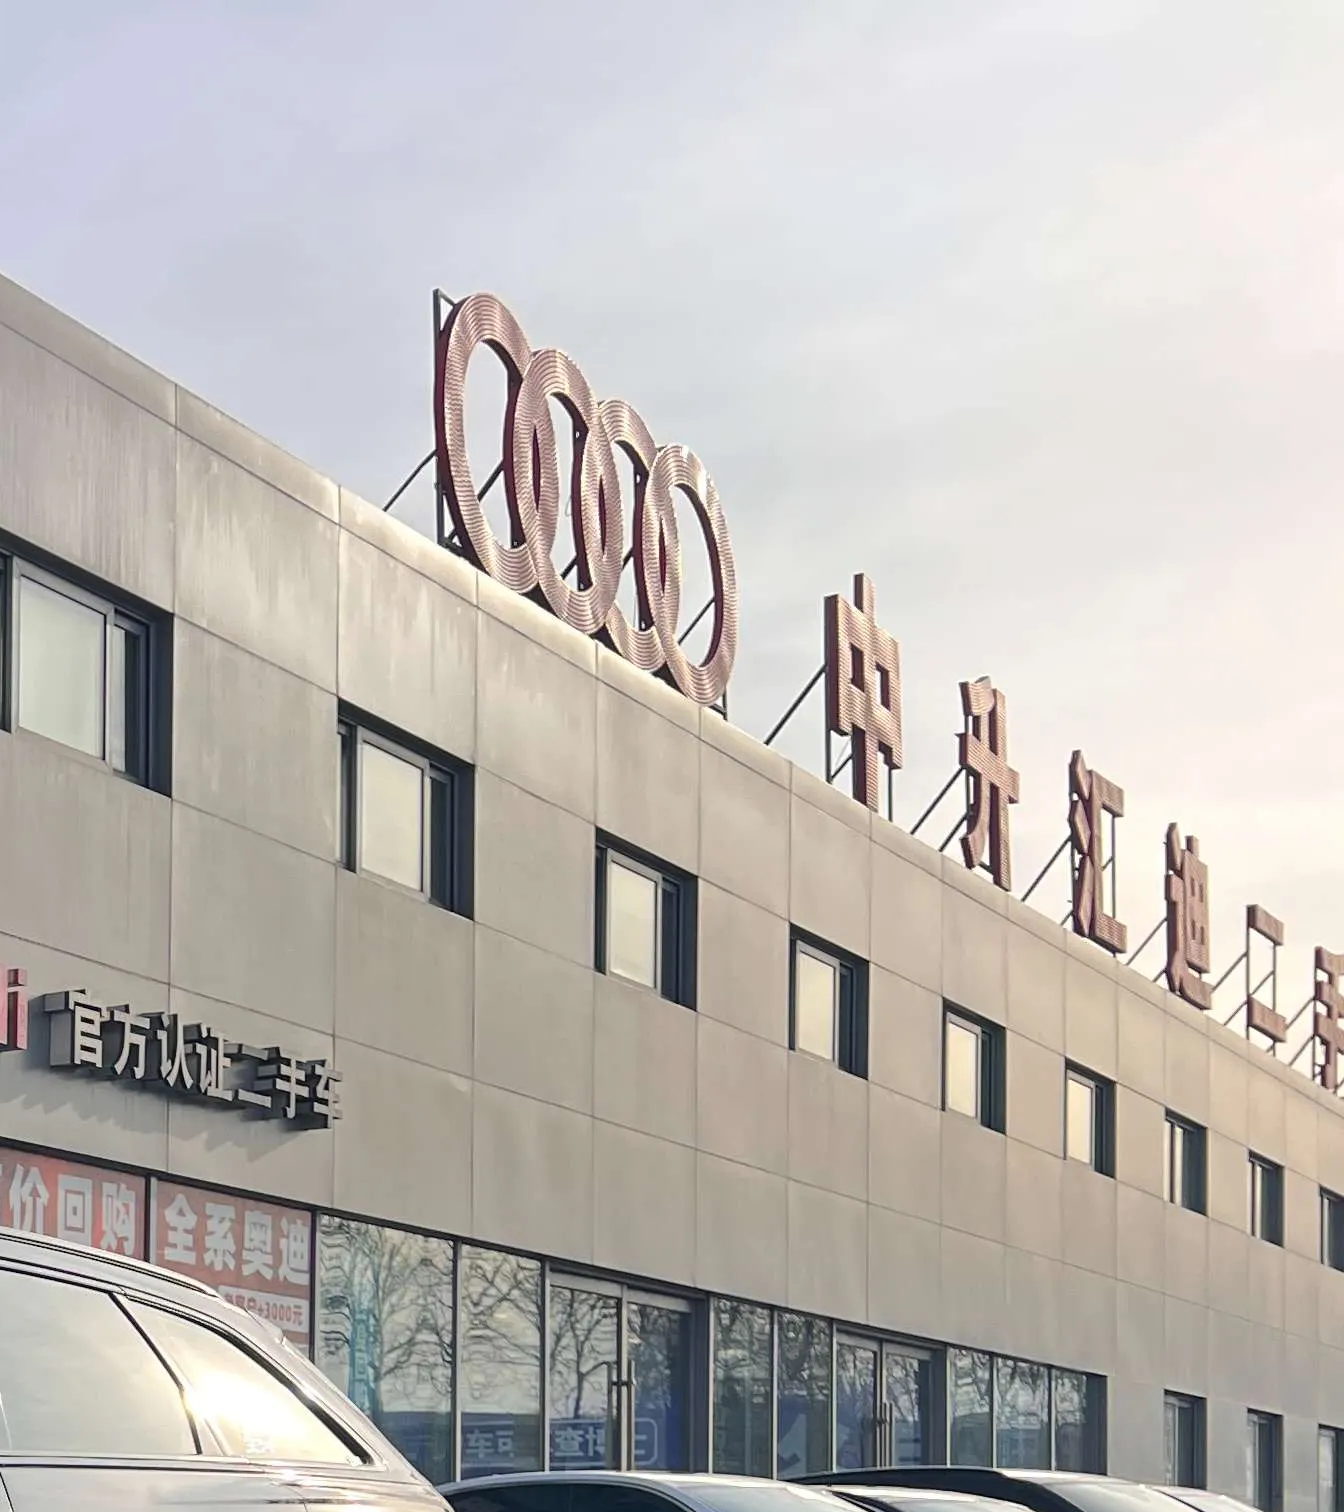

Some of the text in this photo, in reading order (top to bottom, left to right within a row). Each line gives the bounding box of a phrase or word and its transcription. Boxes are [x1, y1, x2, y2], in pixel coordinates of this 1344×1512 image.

[60, 988, 344, 1130] 官方认证二手车
[163, 1195, 310, 1286] 全系奥迪
